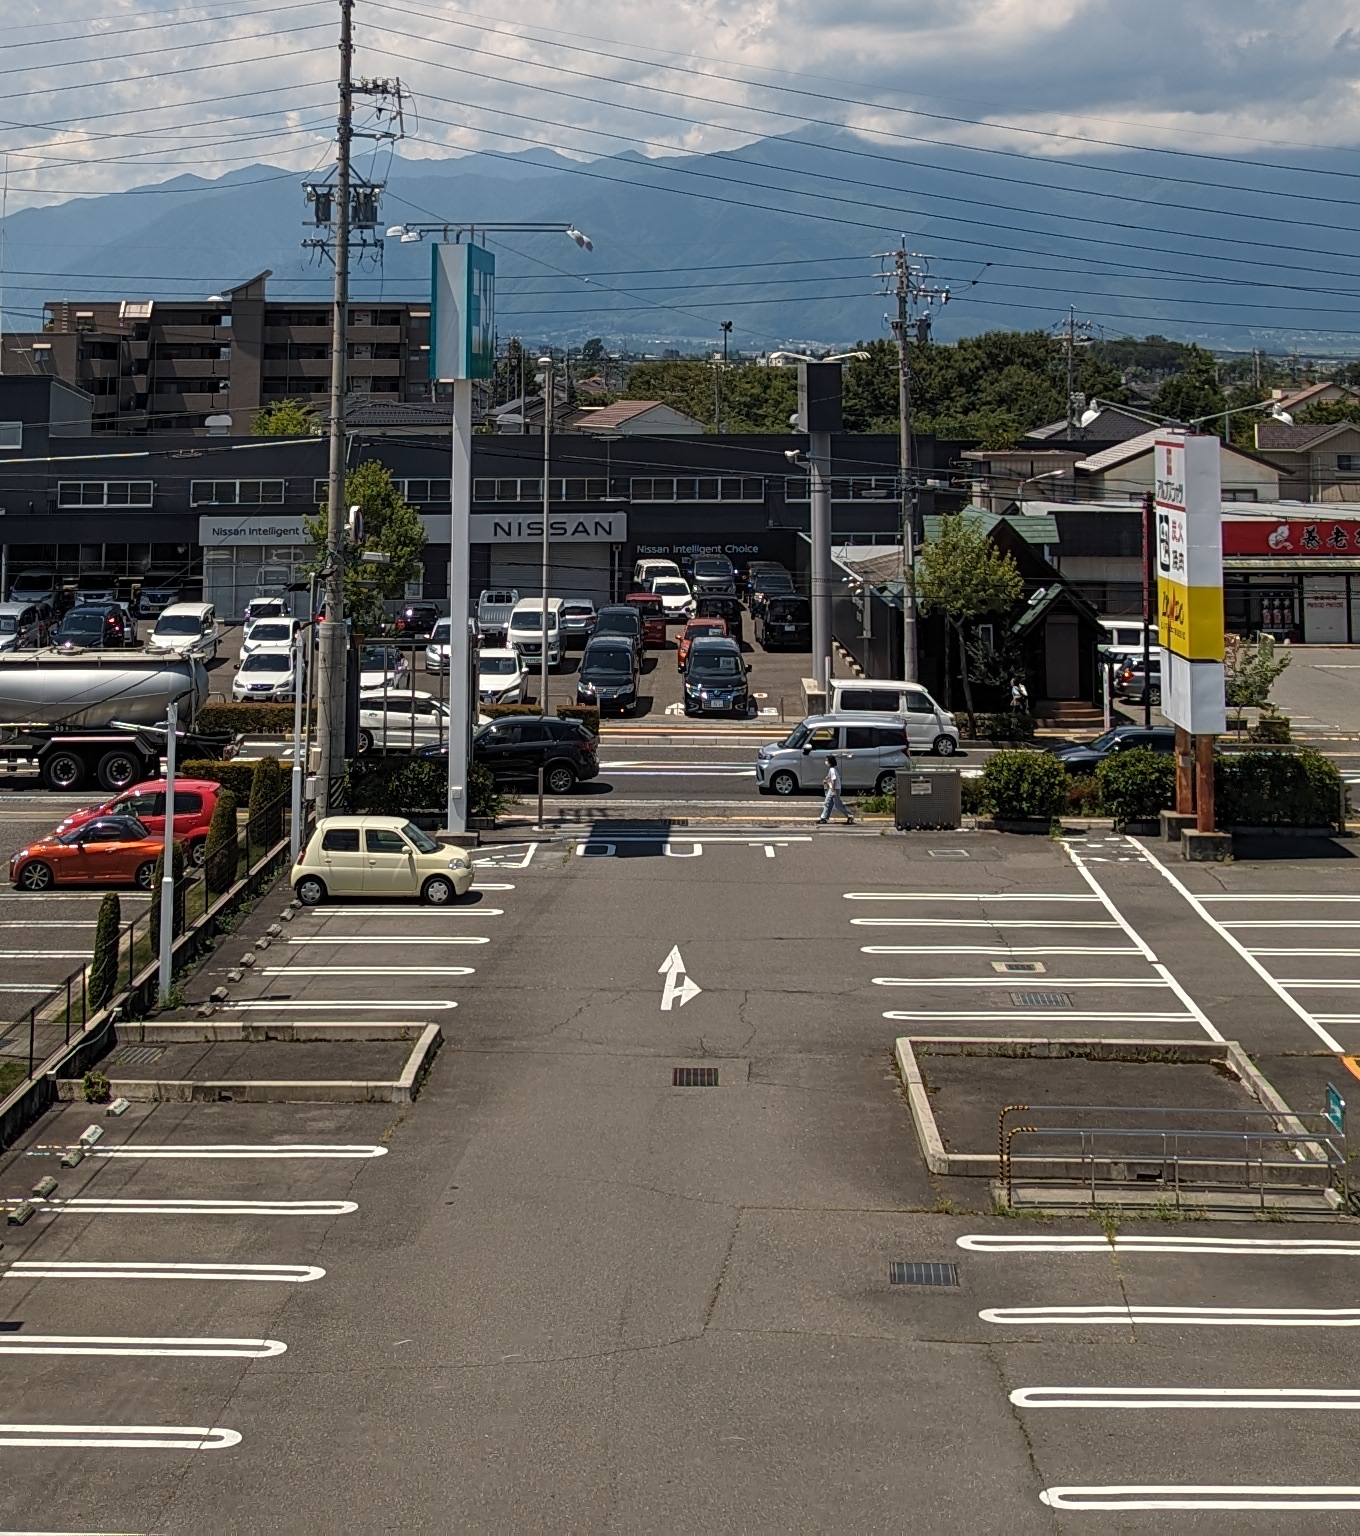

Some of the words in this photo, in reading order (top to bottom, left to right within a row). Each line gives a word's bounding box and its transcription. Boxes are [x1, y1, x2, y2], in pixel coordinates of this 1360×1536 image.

[212, 527, 246, 536] Nissan
[248, 527, 300, 538] Intelligent
[493, 521, 613, 537] NISSAN
[636, 544, 670, 554] Nissan
[672, 544, 722, 555] Intelligent
[724, 543, 759, 554] Choice
[575, 843, 789, 858] OUT
